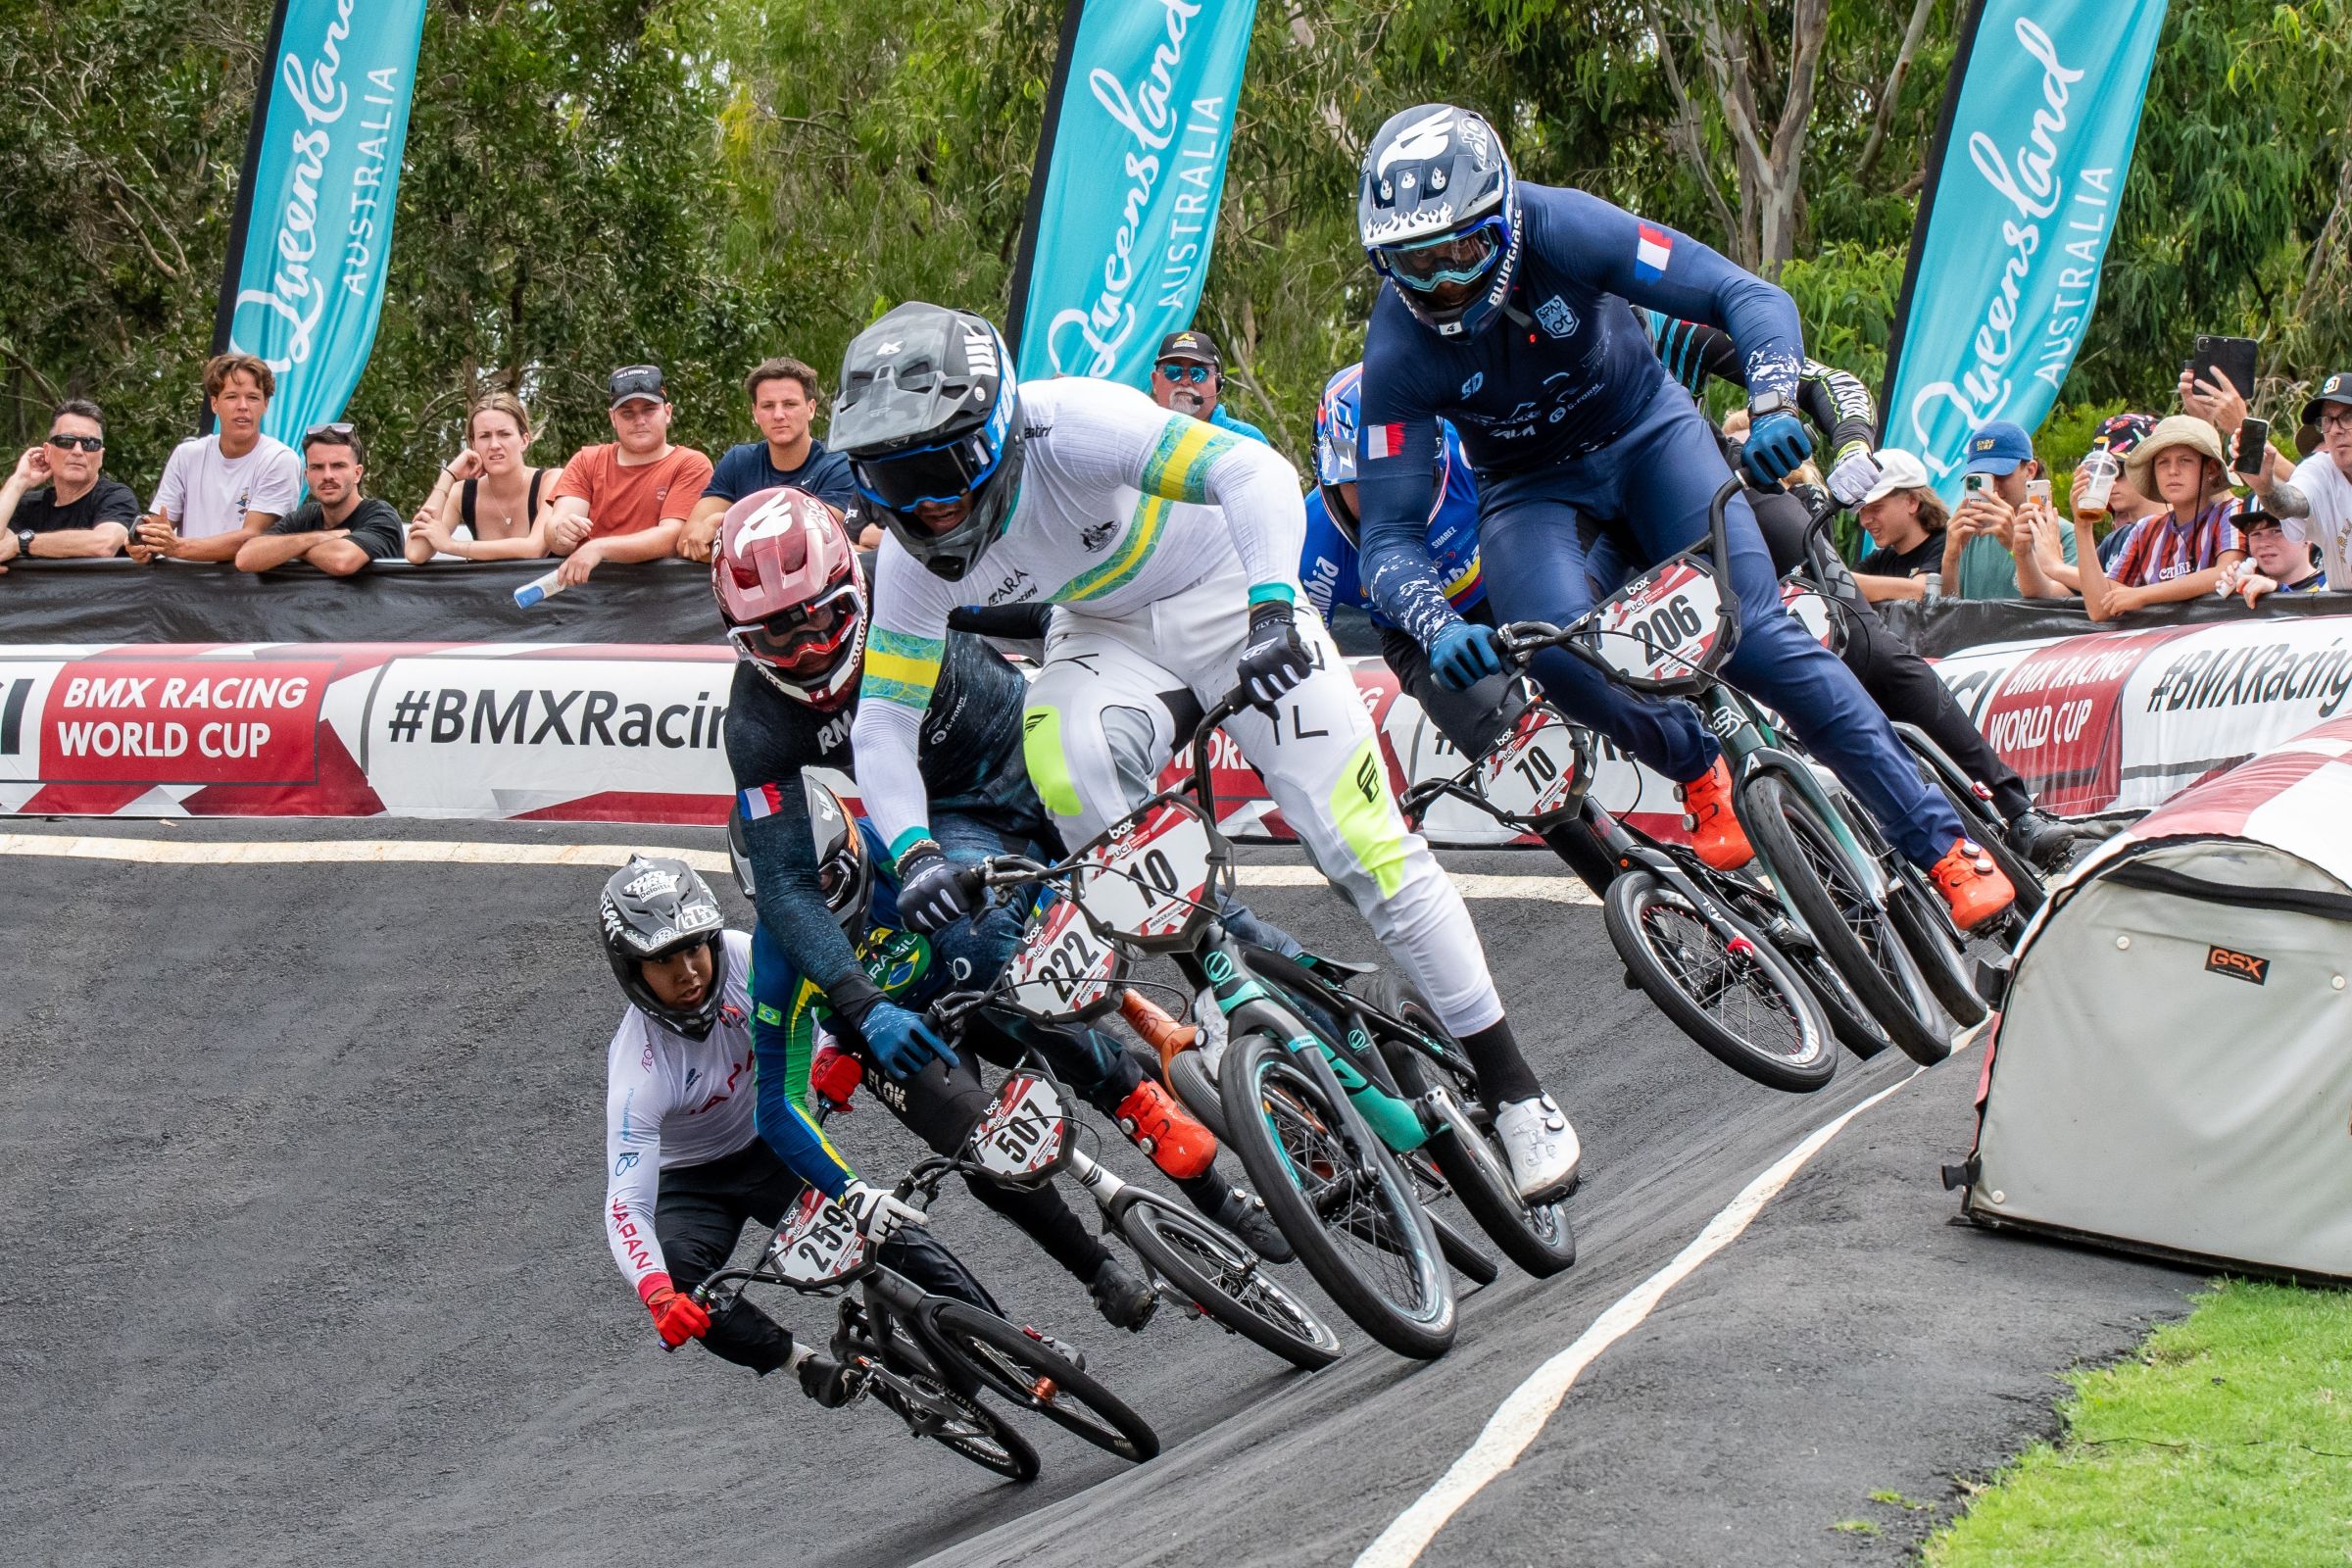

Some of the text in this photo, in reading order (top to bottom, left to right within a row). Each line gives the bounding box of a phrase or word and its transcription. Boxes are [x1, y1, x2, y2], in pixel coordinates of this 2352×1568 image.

[343, 67, 398, 297] AUSTRALIA
[1158, 96, 1224, 309] AUSTRALIA
[1911, 17, 2084, 478] Queensland
[2034, 167, 2113, 390] AUSTRALIA
[1431, 525, 1457, 549] SUAREZ
[1625, 576, 1651, 596] box
[1631, 599, 1645, 612] UCI
[1632, 595, 1701, 666] 206
[2003, 648, 2143, 698] BMX RACING
[63, 677, 310, 709] BMX RACING
[57, 721, 271, 759] WORLD CUP
[1495, 728, 1515, 747] box
[1989, 698, 2093, 755] WORLD CUP
[1174, 731, 1252, 769] WORL
[1502, 748, 1514, 761] UCI
[1514, 746, 1556, 795] 70
[1108, 818, 1136, 840] box
[1113, 843, 1131, 858] UCI
[1128, 849, 1178, 908] 10
[1022, 923, 1043, 945] box
[1033, 944, 1044, 958] UCI
[1039, 931, 1100, 1004] 222
[2211, 949, 2265, 980] GSX
[983, 1098, 1002, 1116] box
[994, 1114, 1003, 1128] UCI
[995, 1098, 1051, 1163] 507
[782, 1206, 800, 1225] box
[792, 1224, 804, 1238] UCI
[612, 1198, 654, 1270] JAPAN
[798, 1204, 854, 1274] 259
